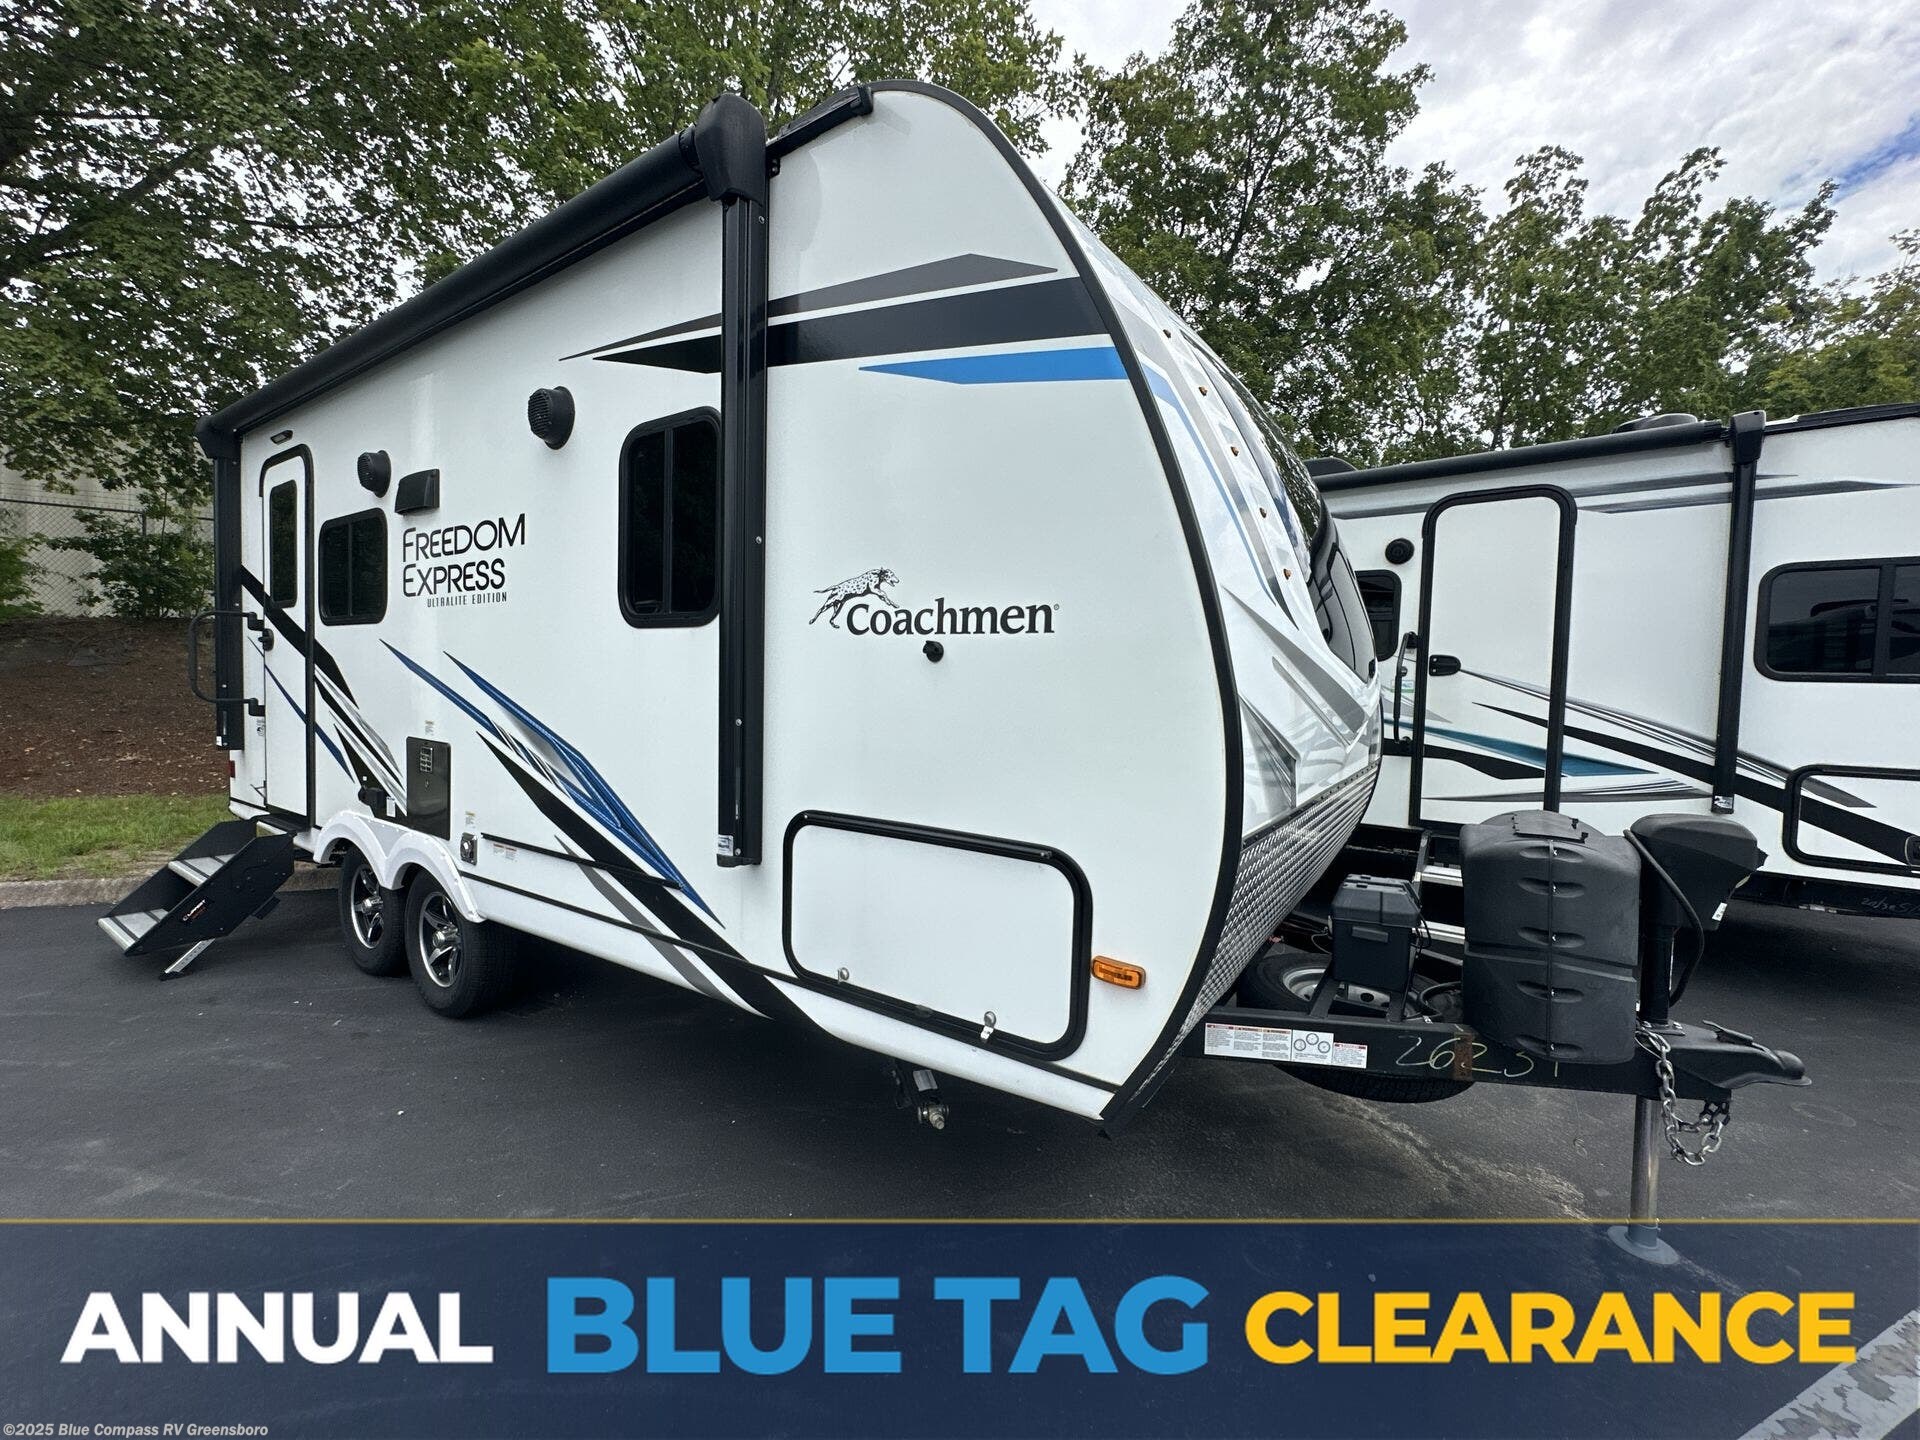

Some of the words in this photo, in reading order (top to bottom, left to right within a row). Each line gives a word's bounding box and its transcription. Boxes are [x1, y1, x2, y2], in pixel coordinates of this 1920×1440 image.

[402, 513, 526, 562] FREEDOM
[402, 558, 506, 597] EXPRESS
[427, 595, 468, 608] ULTRALITE
[472, 591, 508, 605] EDITION
[846, 597, 1055, 636] Coachmen
